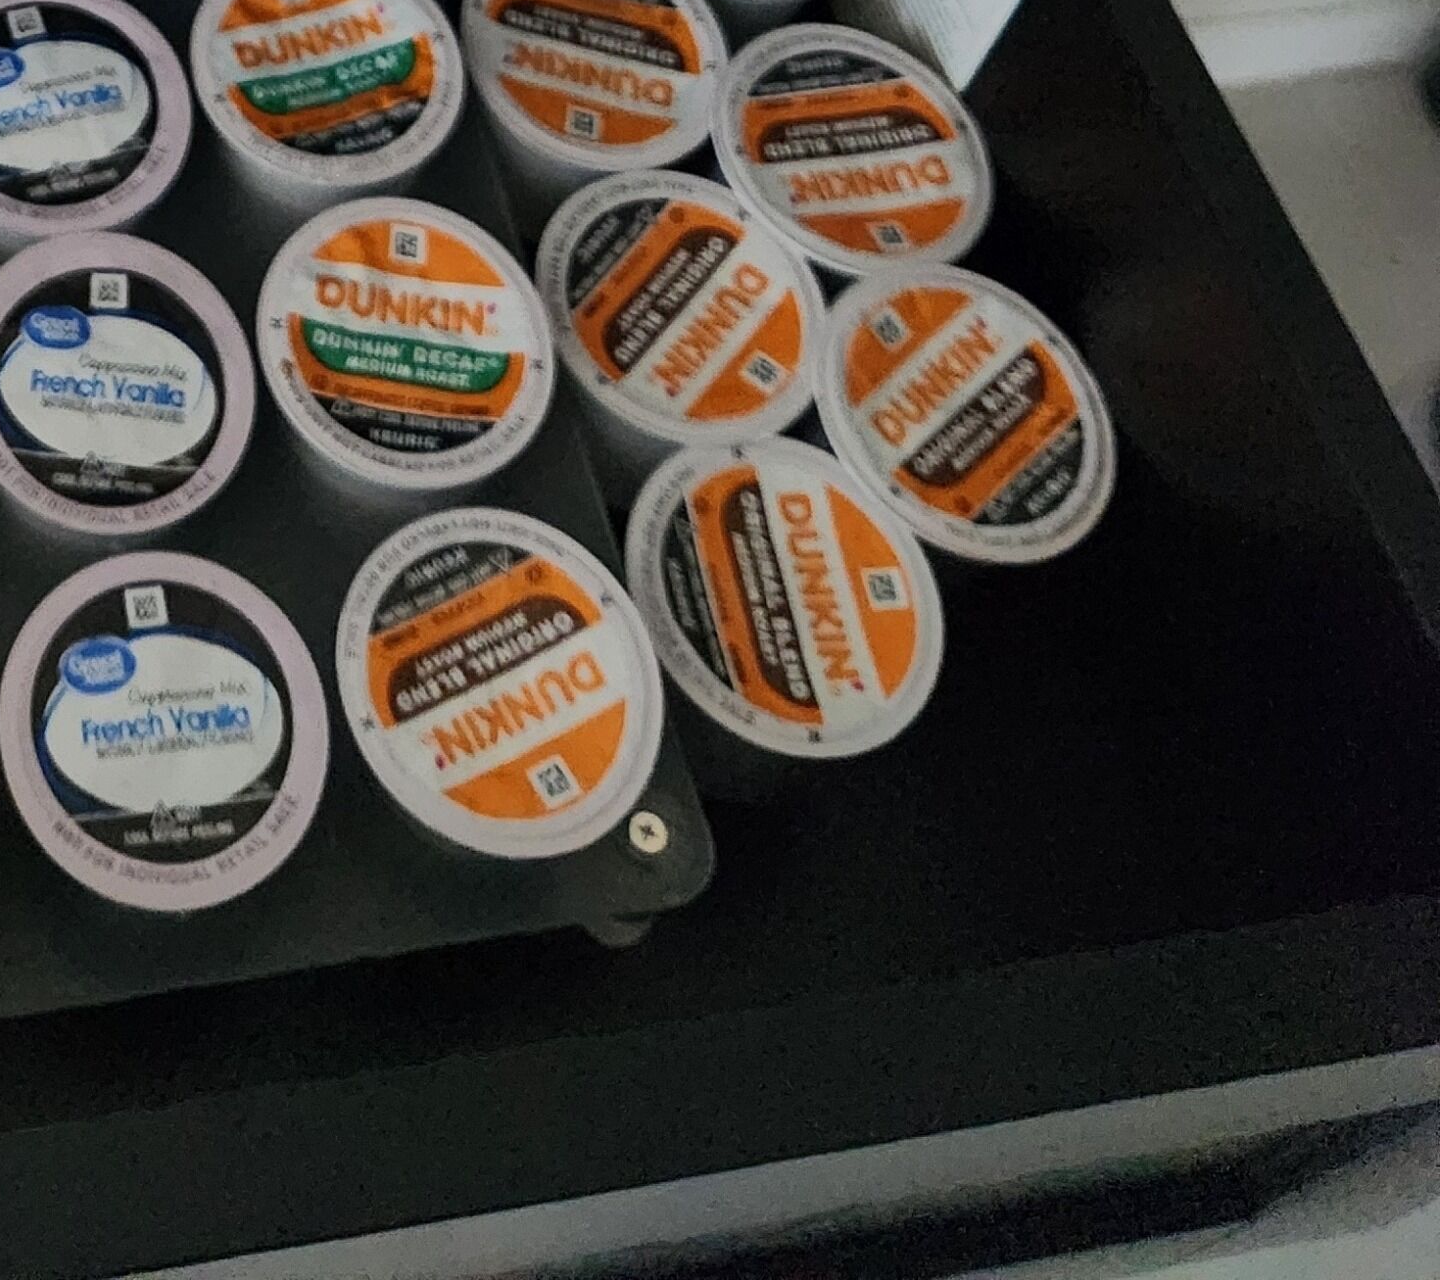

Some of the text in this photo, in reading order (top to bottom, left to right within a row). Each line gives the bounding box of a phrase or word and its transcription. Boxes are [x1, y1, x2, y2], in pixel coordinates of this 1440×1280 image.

[30, 368, 187, 408] French Vanilla
[776, 492, 865, 693] DUNKIN'
[394, 610, 576, 715] ORIGINAL BLEND
[430, 649, 609, 772] DUNKIN'
[80, 701, 250, 747] French Vanilla
